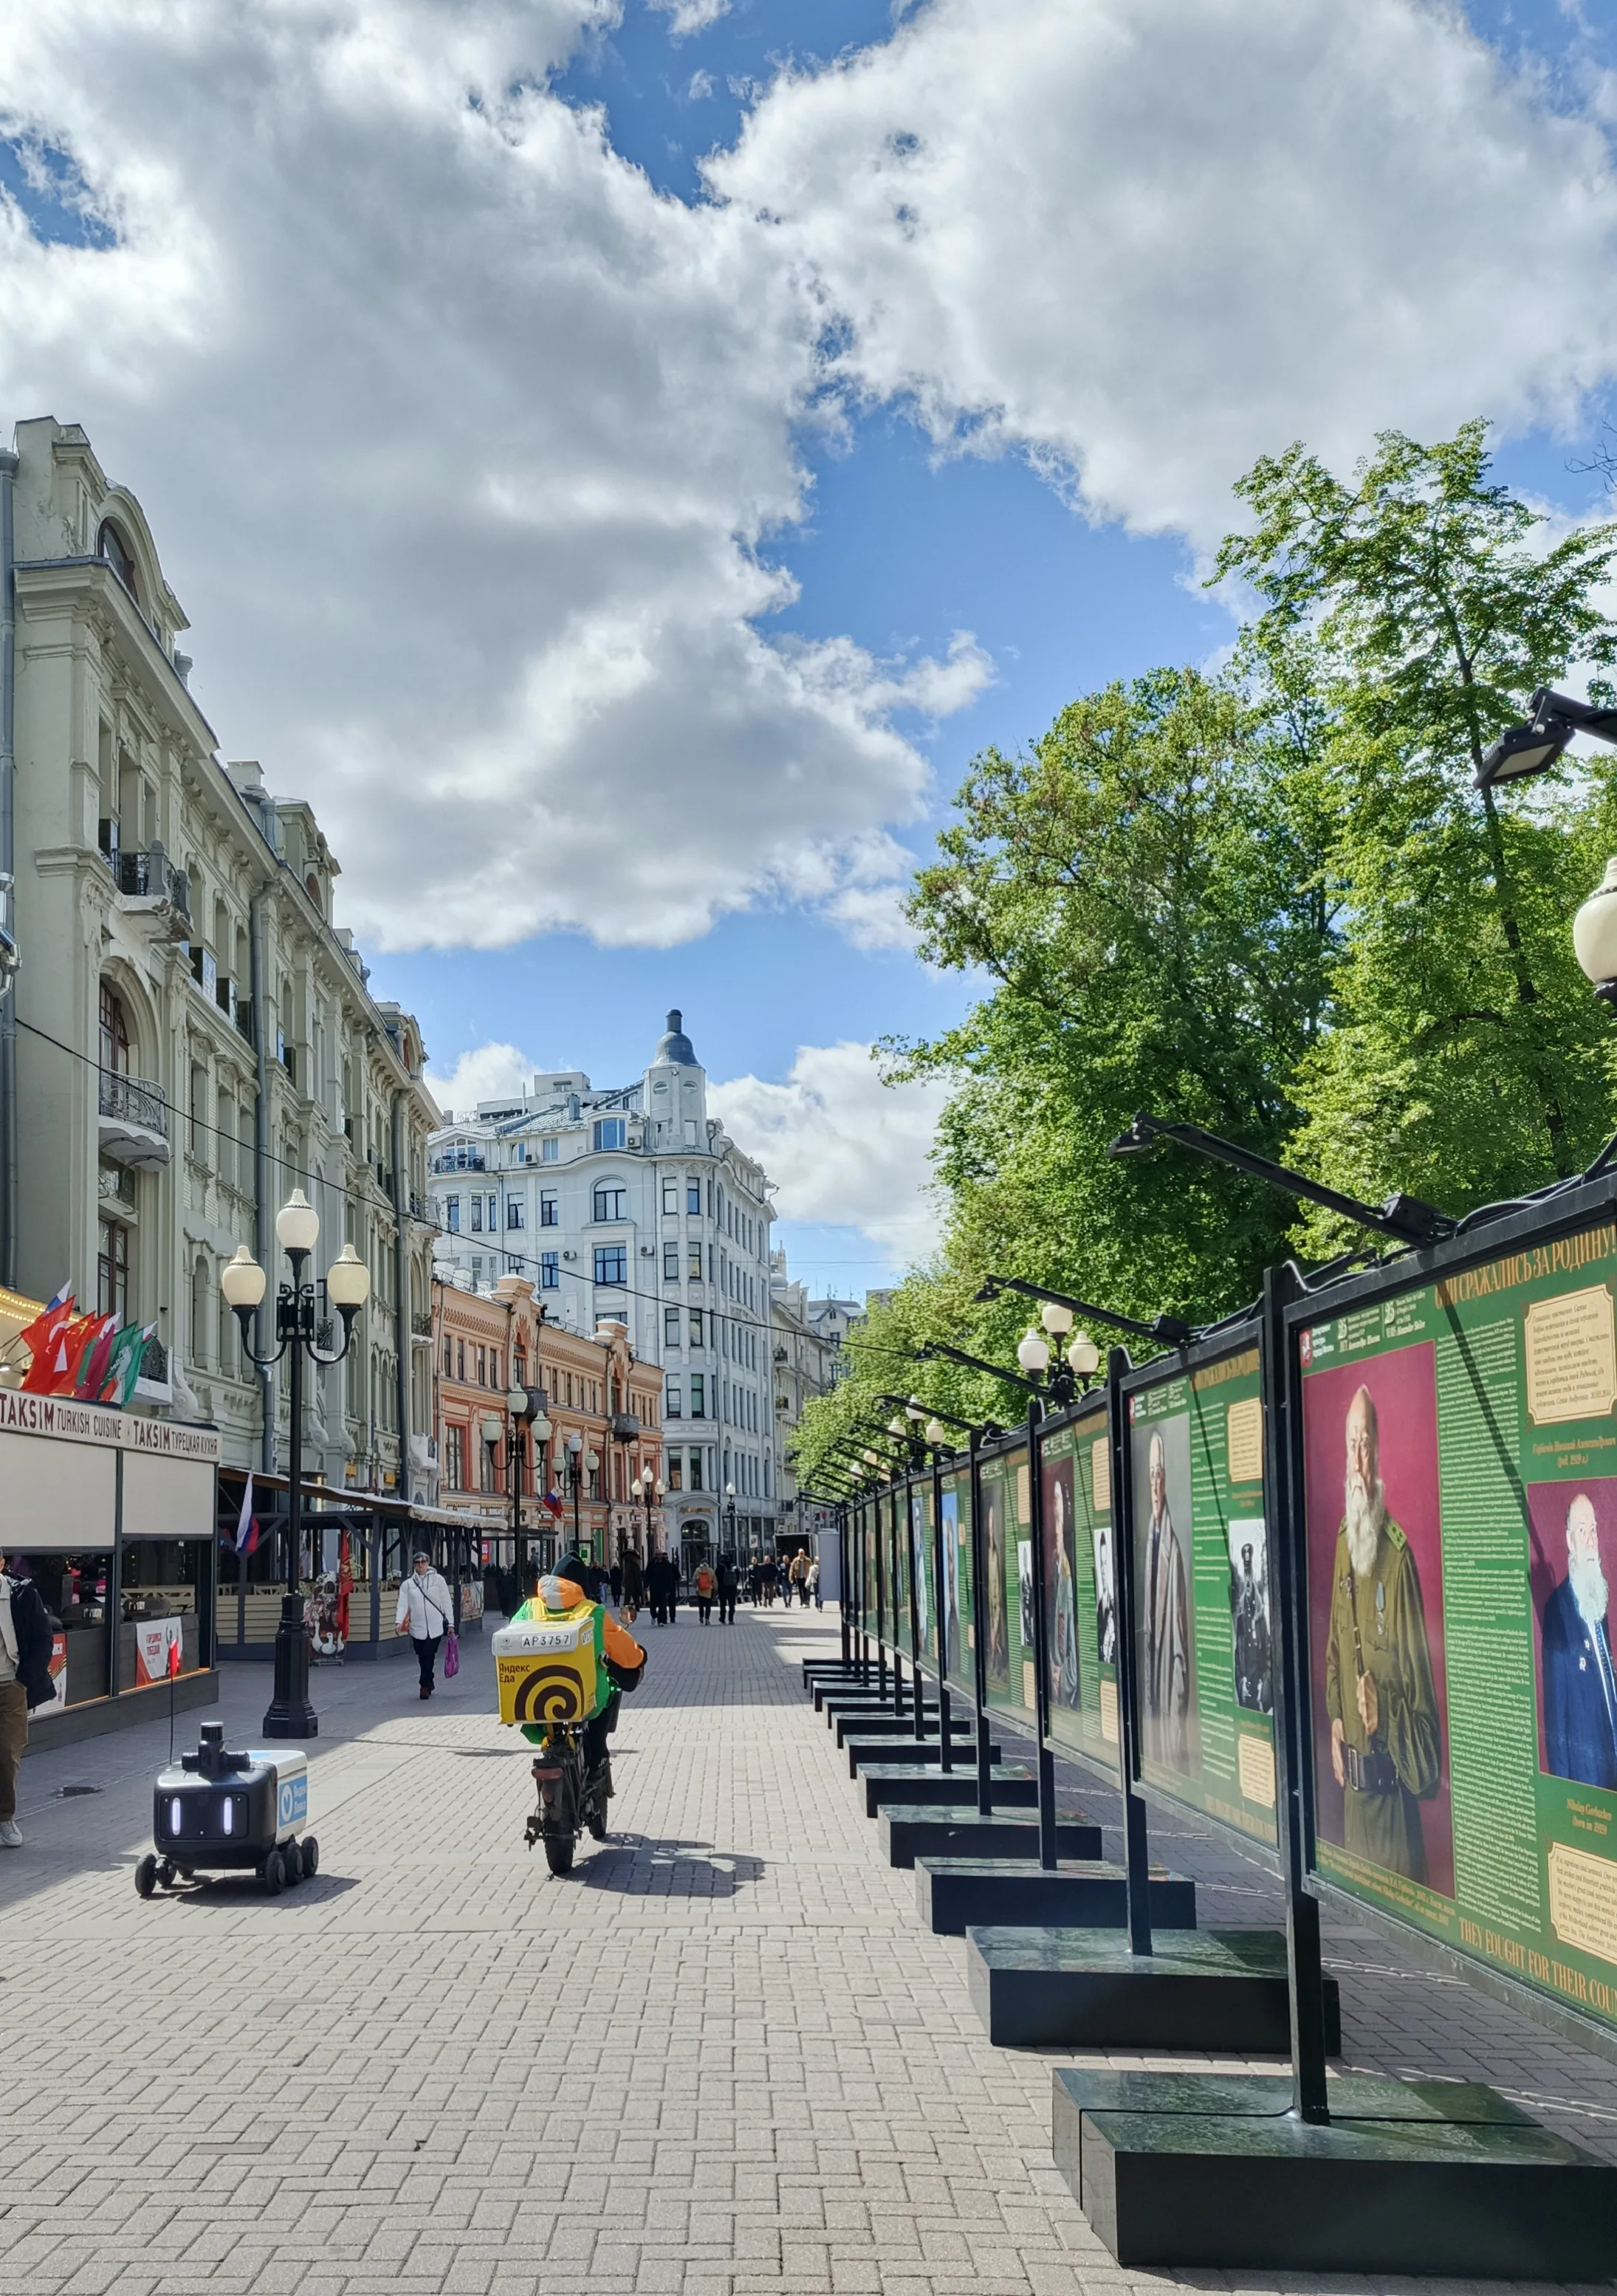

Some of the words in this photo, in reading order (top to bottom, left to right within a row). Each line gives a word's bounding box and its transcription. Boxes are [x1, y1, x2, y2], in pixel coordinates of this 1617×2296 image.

[1459, 1251, 1532, 1303] СРАЖАЛИСЬ
[1533, 1245, 1551, 1278] ЗА
[1551, 1223, 1616, 1273] РОДИНУ!
[0, 1393, 54, 1431] TAKSIM
[57, 1407, 90, 1434] TURKISH
[93, 1415, 122, 1440] CUISINE
[134, 1420, 171, 1450] TAKSIM
[171, 1431, 200, 1454] ТУРЕЦКАЯ
[200, 1436, 218, 1455] КУХНЯ
[498, 1663, 531, 1674] Яндекс
[499, 1673, 515, 1683] Еда
[1459, 1917, 1483, 1949] THEY
[1485, 1928, 1525, 1970] FOUGHT
[1528, 1949, 1550, 1983] FOR
[1551, 1959, 1587, 2001] THEIR
